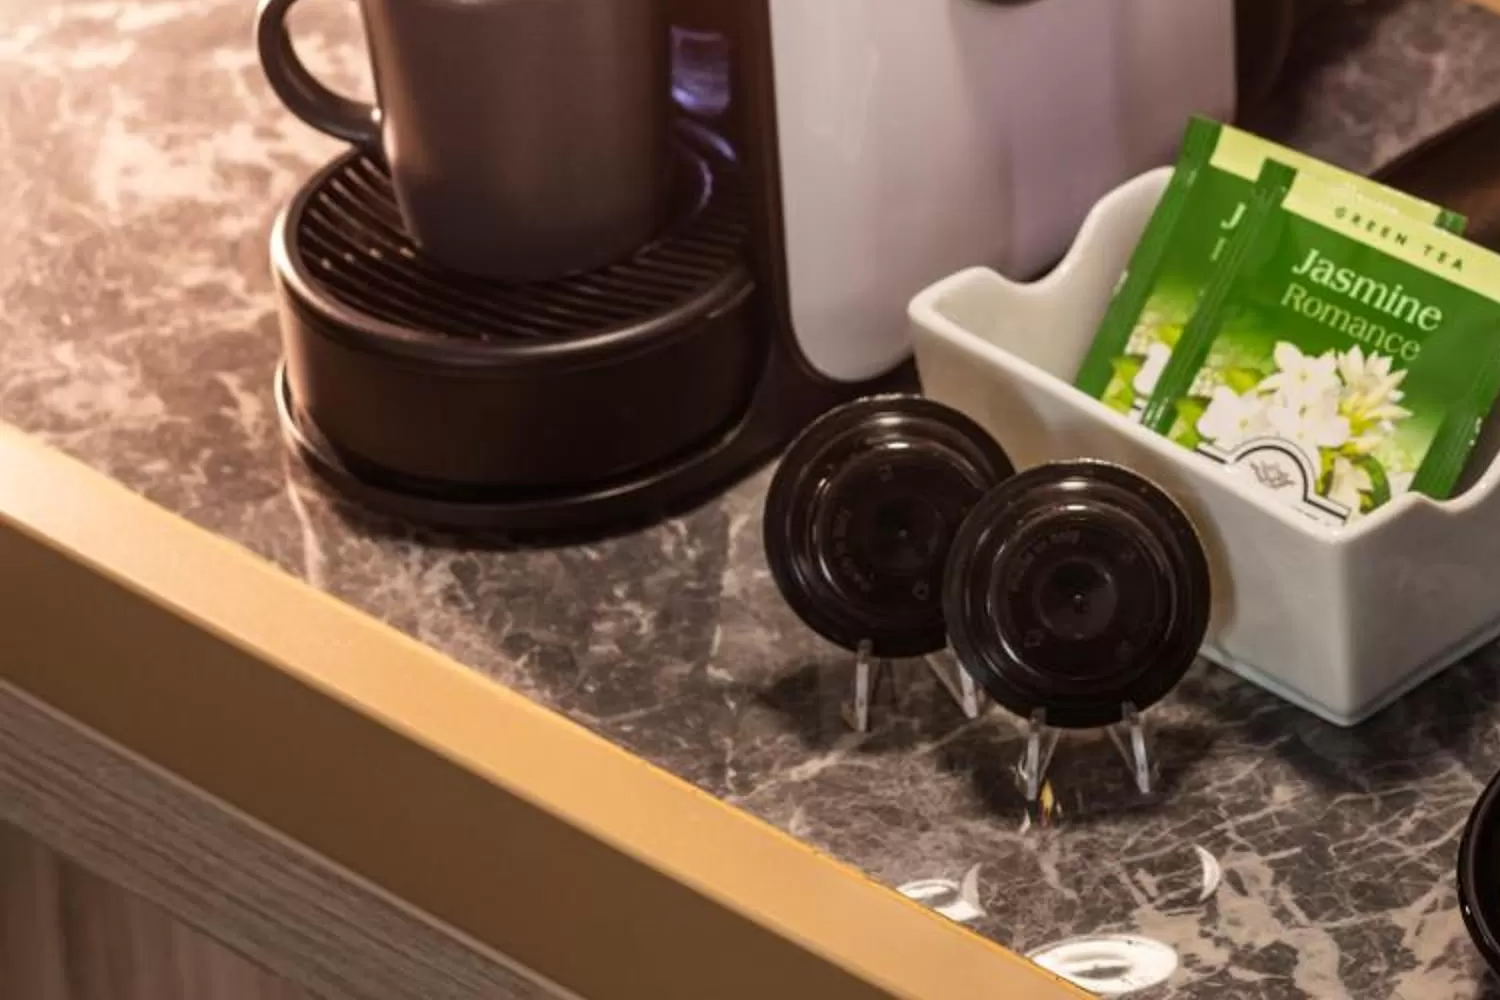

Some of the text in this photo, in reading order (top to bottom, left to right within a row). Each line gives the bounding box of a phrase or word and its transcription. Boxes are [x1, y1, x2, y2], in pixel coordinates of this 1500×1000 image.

[1334, 206, 1463, 271] GREEN TEA
[1281, 282, 1421, 361] Romance
[1291, 248, 1442, 331] Jasmine
